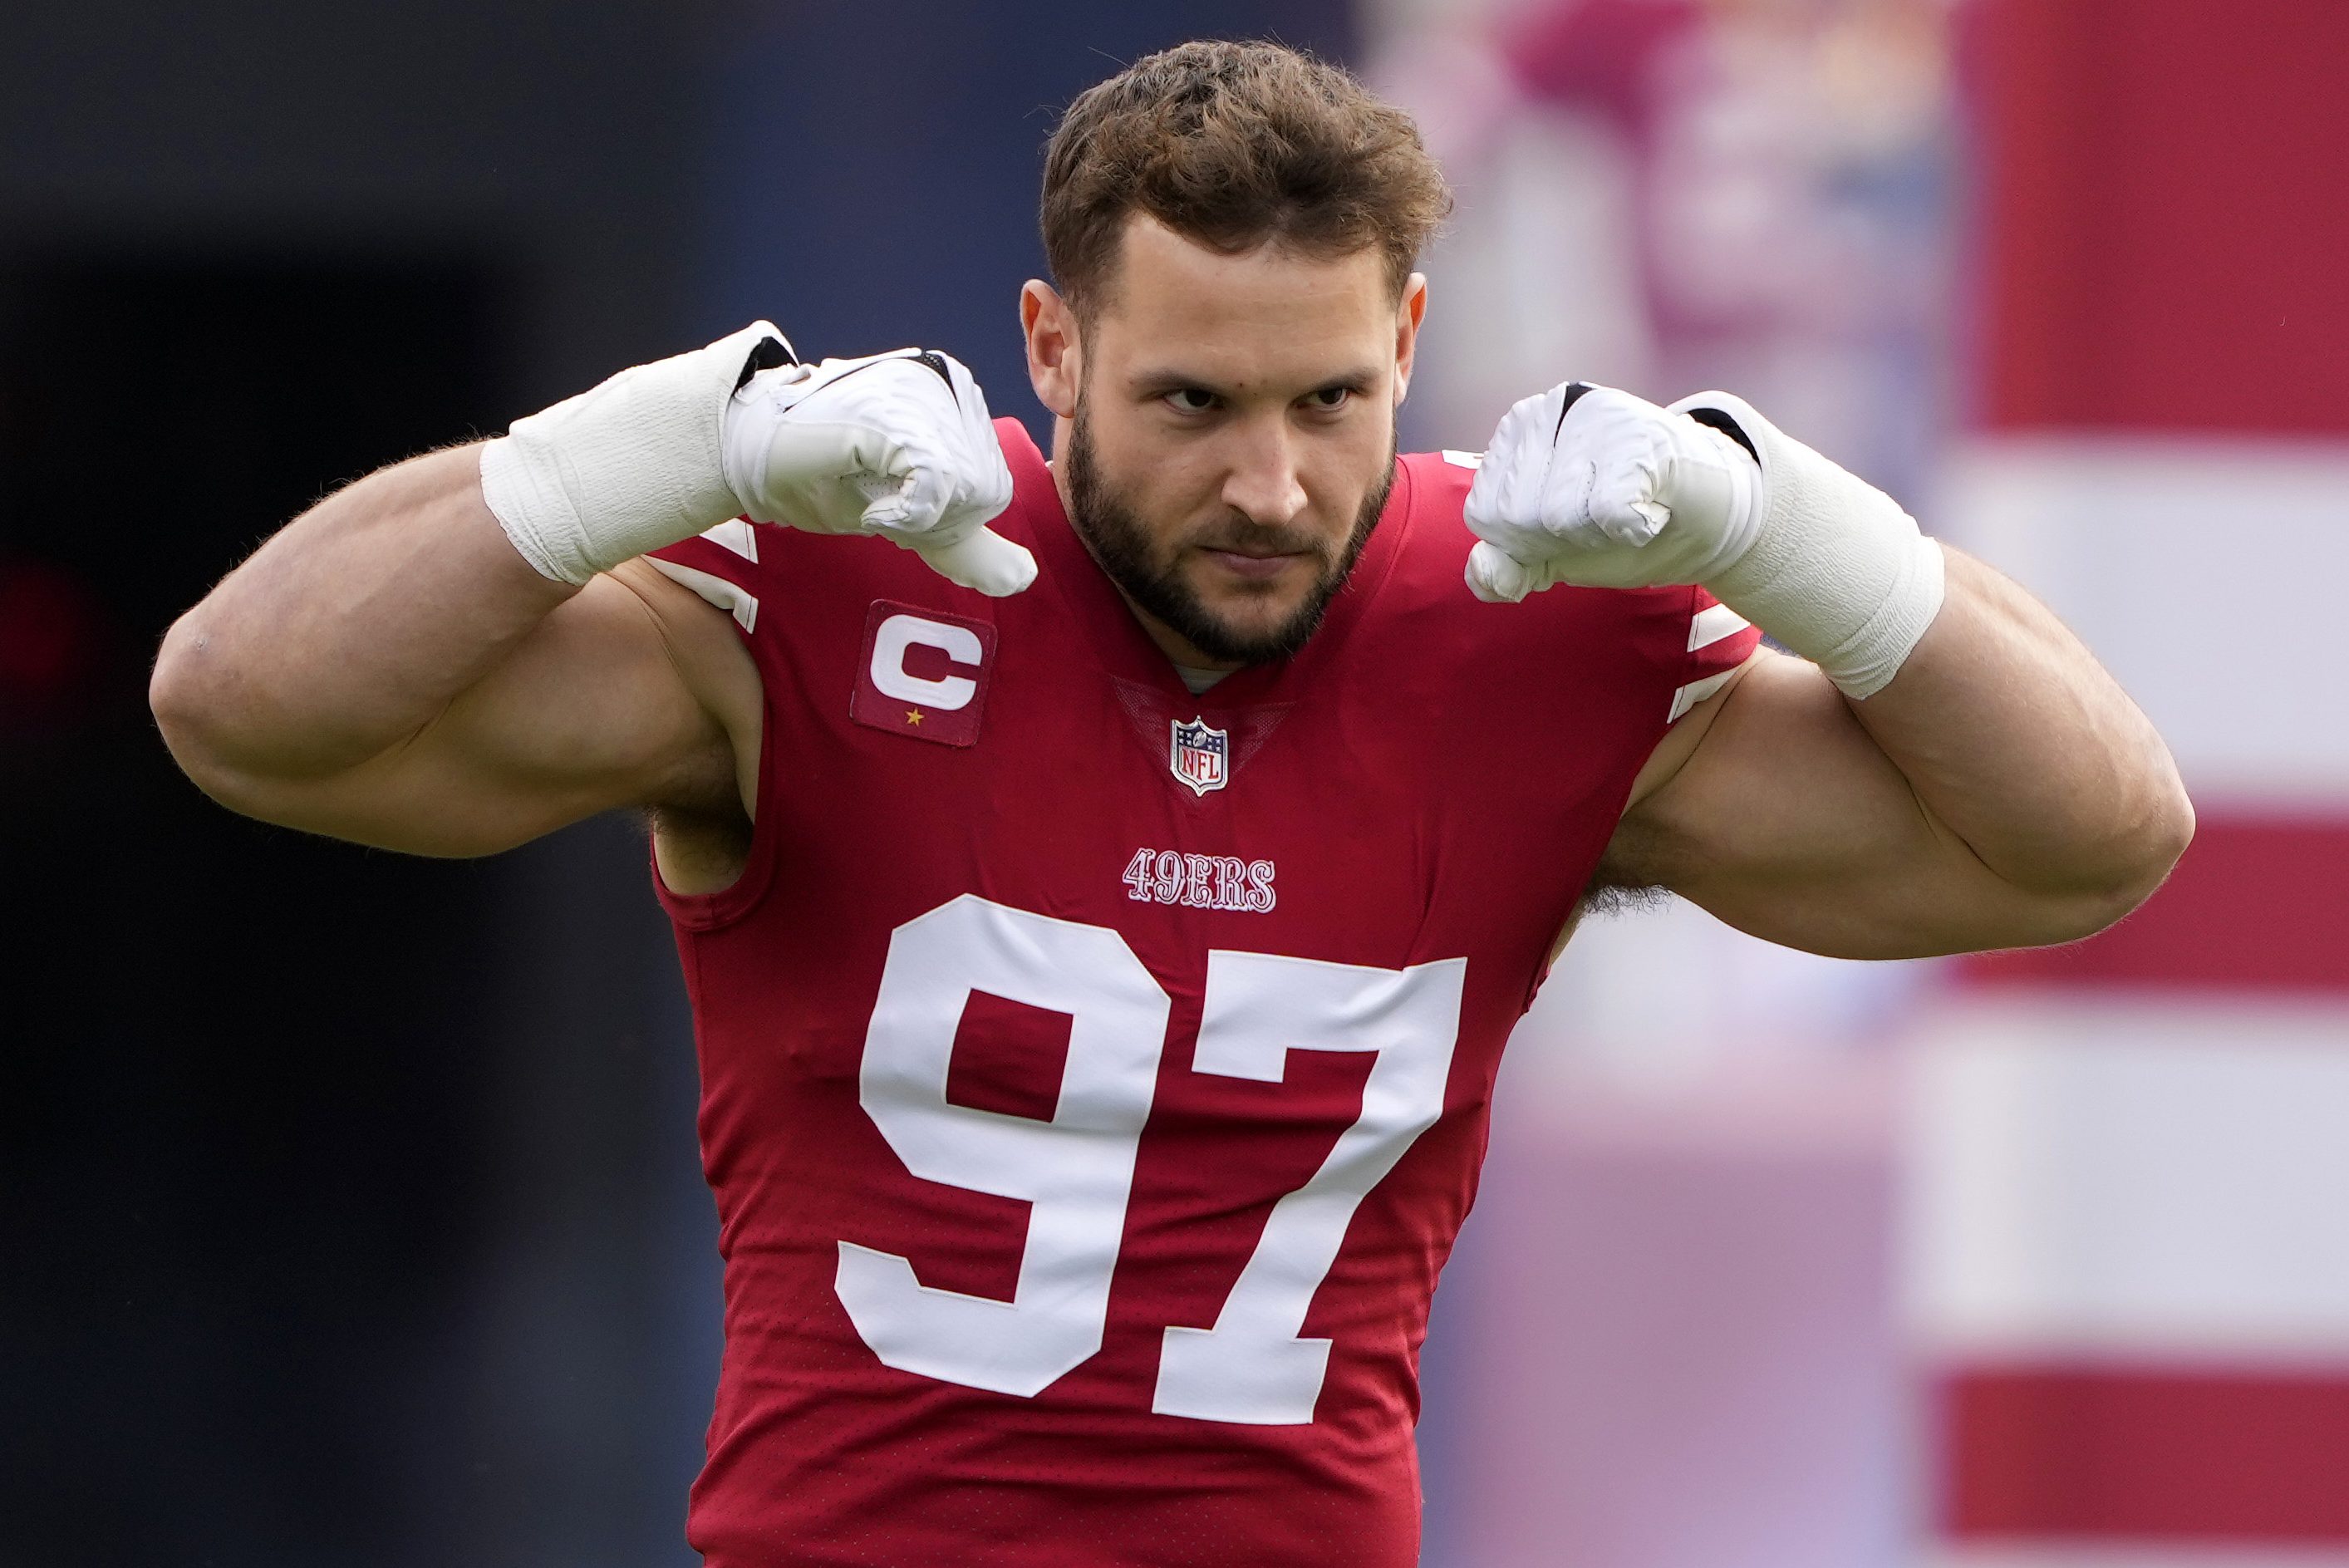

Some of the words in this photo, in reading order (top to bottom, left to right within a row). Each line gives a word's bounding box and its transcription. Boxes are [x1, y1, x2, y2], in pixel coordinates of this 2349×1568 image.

[870, 614, 982, 710] C
[1181, 747, 1219, 781] NFL
[1123, 848, 1276, 913] 49ERS
[834, 893, 1467, 1424] 97
